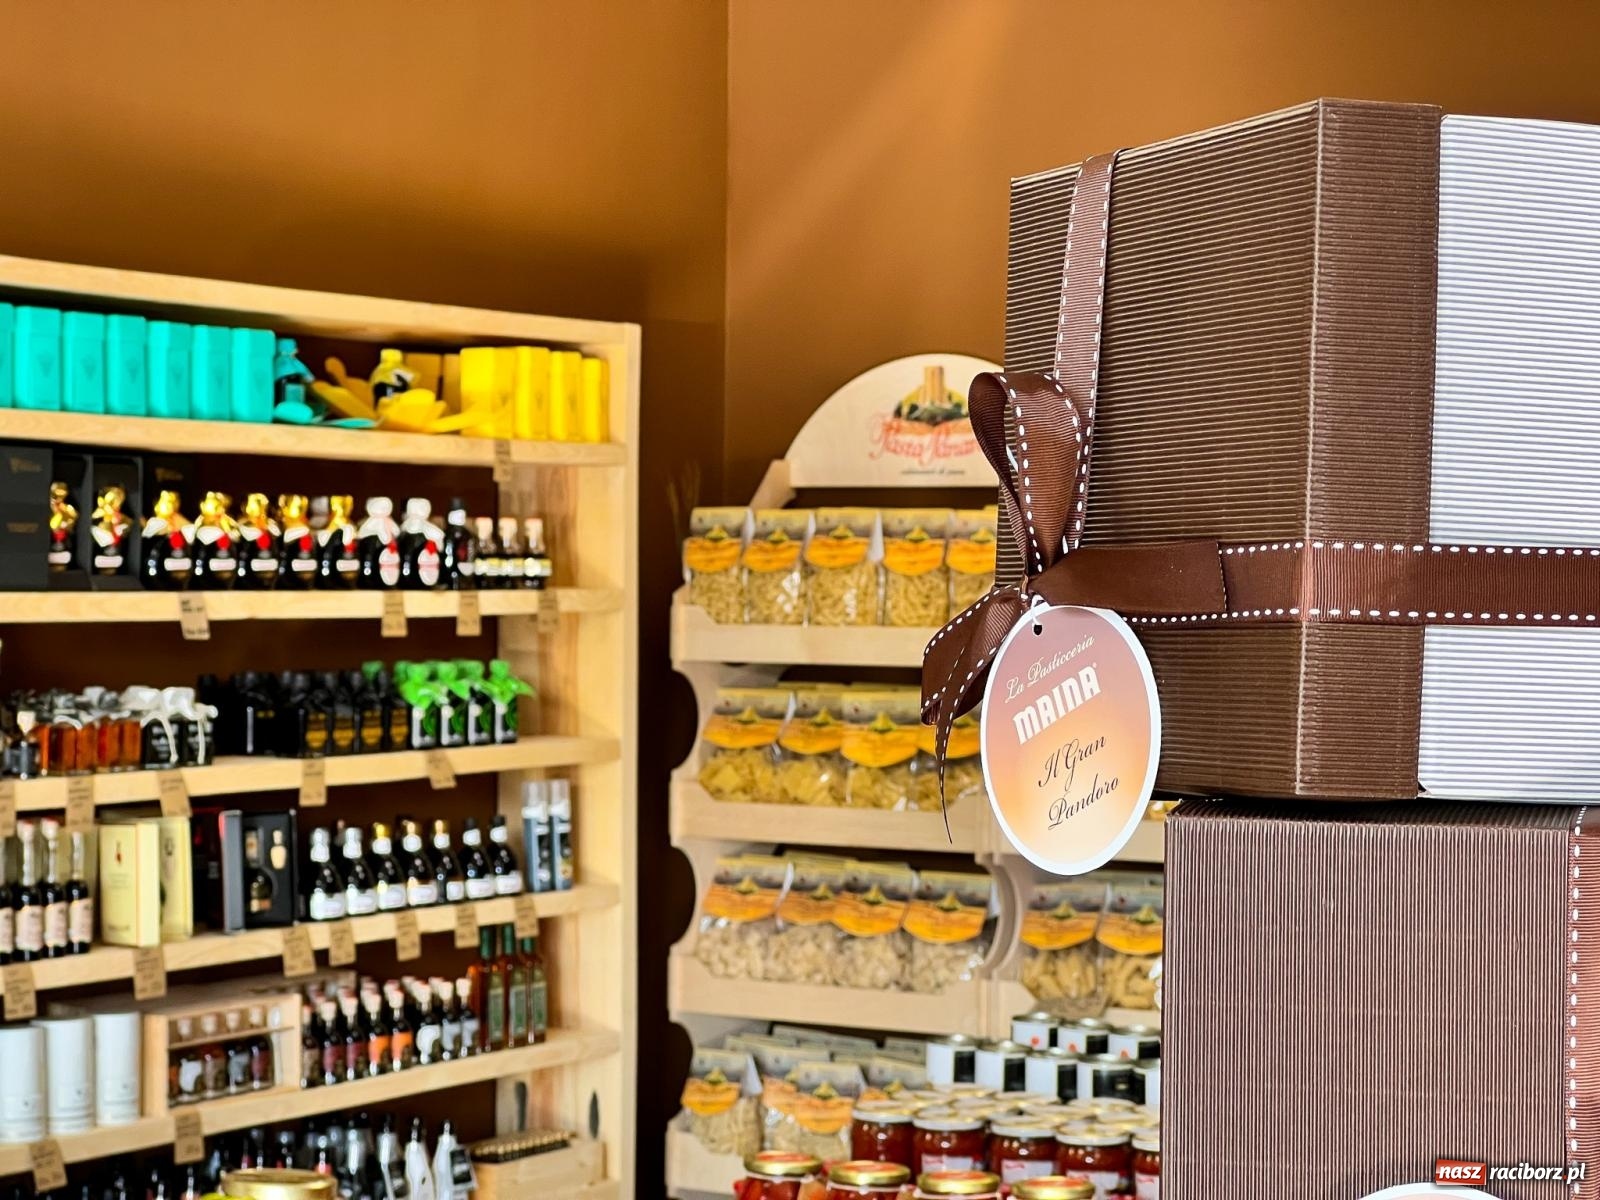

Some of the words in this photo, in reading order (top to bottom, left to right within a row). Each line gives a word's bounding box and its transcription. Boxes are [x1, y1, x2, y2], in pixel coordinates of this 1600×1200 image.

[1004, 676, 1026, 704] La
[1026, 634, 1096, 687] Pasticceria
[1037, 748, 1060, 788] Il
[1063, 736, 1107, 792] Gran
[1047, 773, 1120, 831] Pandoro
